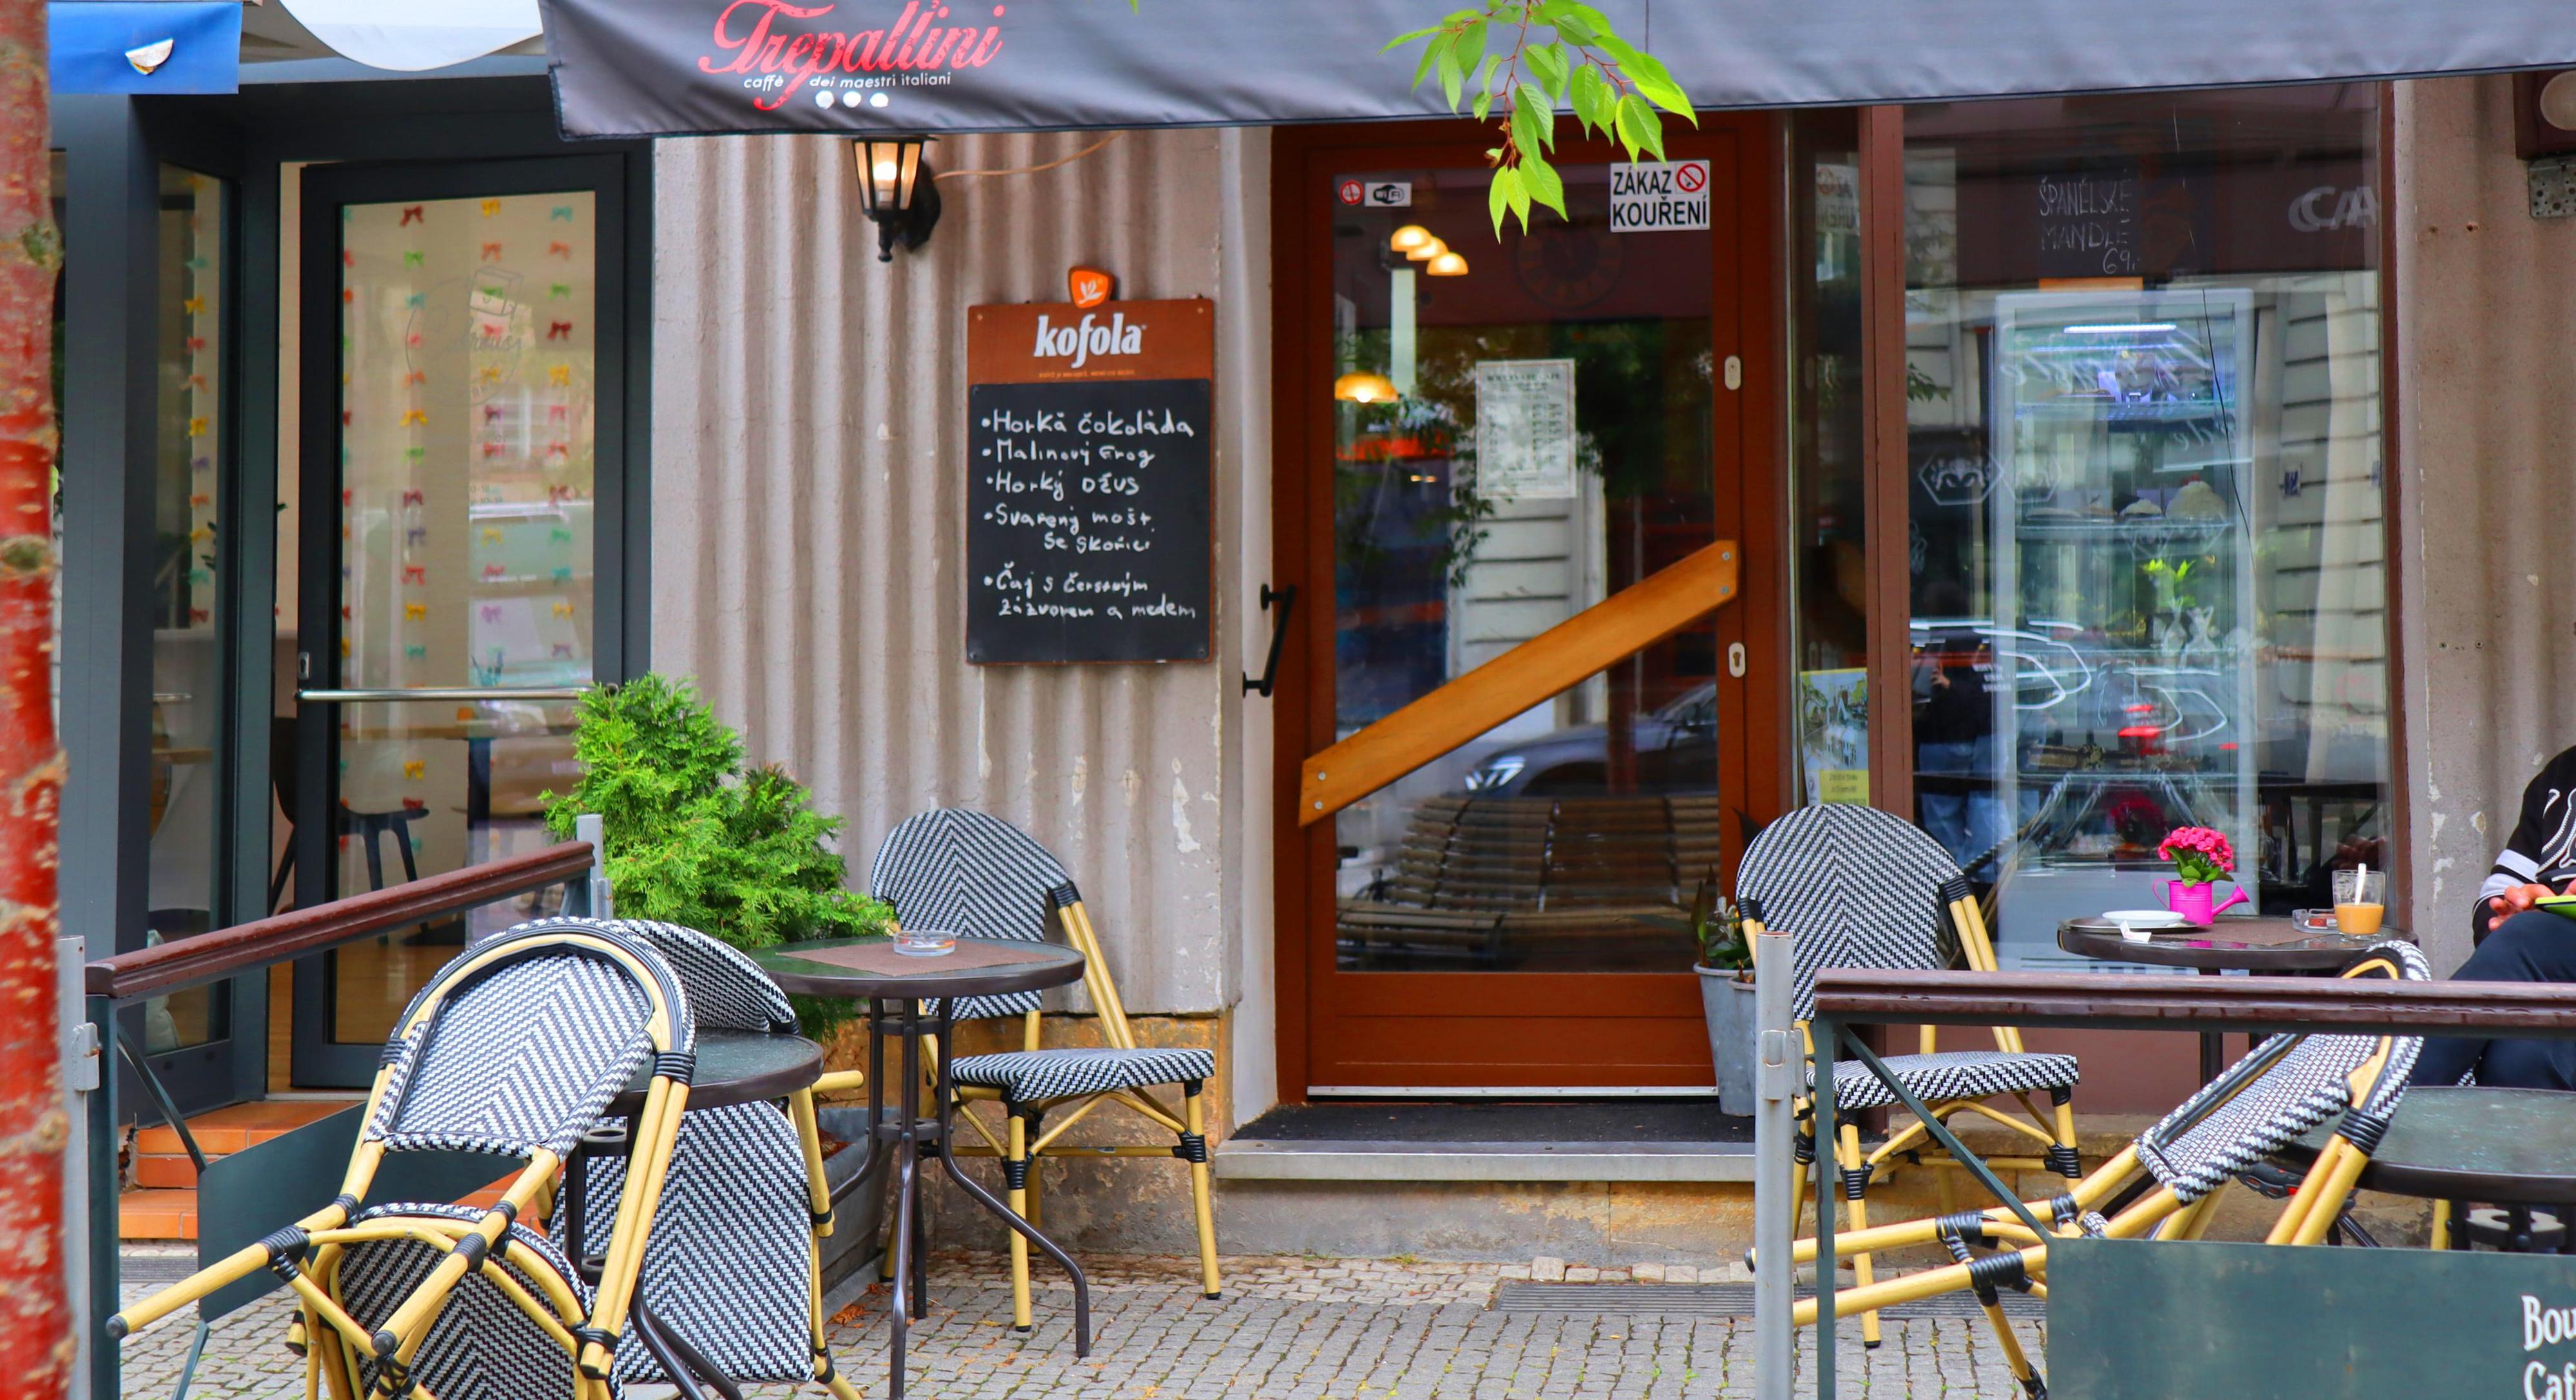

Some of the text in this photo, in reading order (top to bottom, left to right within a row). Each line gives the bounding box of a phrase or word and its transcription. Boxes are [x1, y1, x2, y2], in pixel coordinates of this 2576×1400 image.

[698, 0, 1005, 110] Trepallini
[743, 71, 951, 91] caffè dei maestri italiani
[1613, 165, 1672, 196] ZÁKAZ
[1612, 194, 1707, 227] KOUŘENÍ
[1033, 312, 1142, 369] kofola
[996, 438, 1090, 466] Malinový
[996, 469, 1065, 502] Horký
[1106, 605, 1124, 620] a
[1132, 592, 1196, 619] medem
